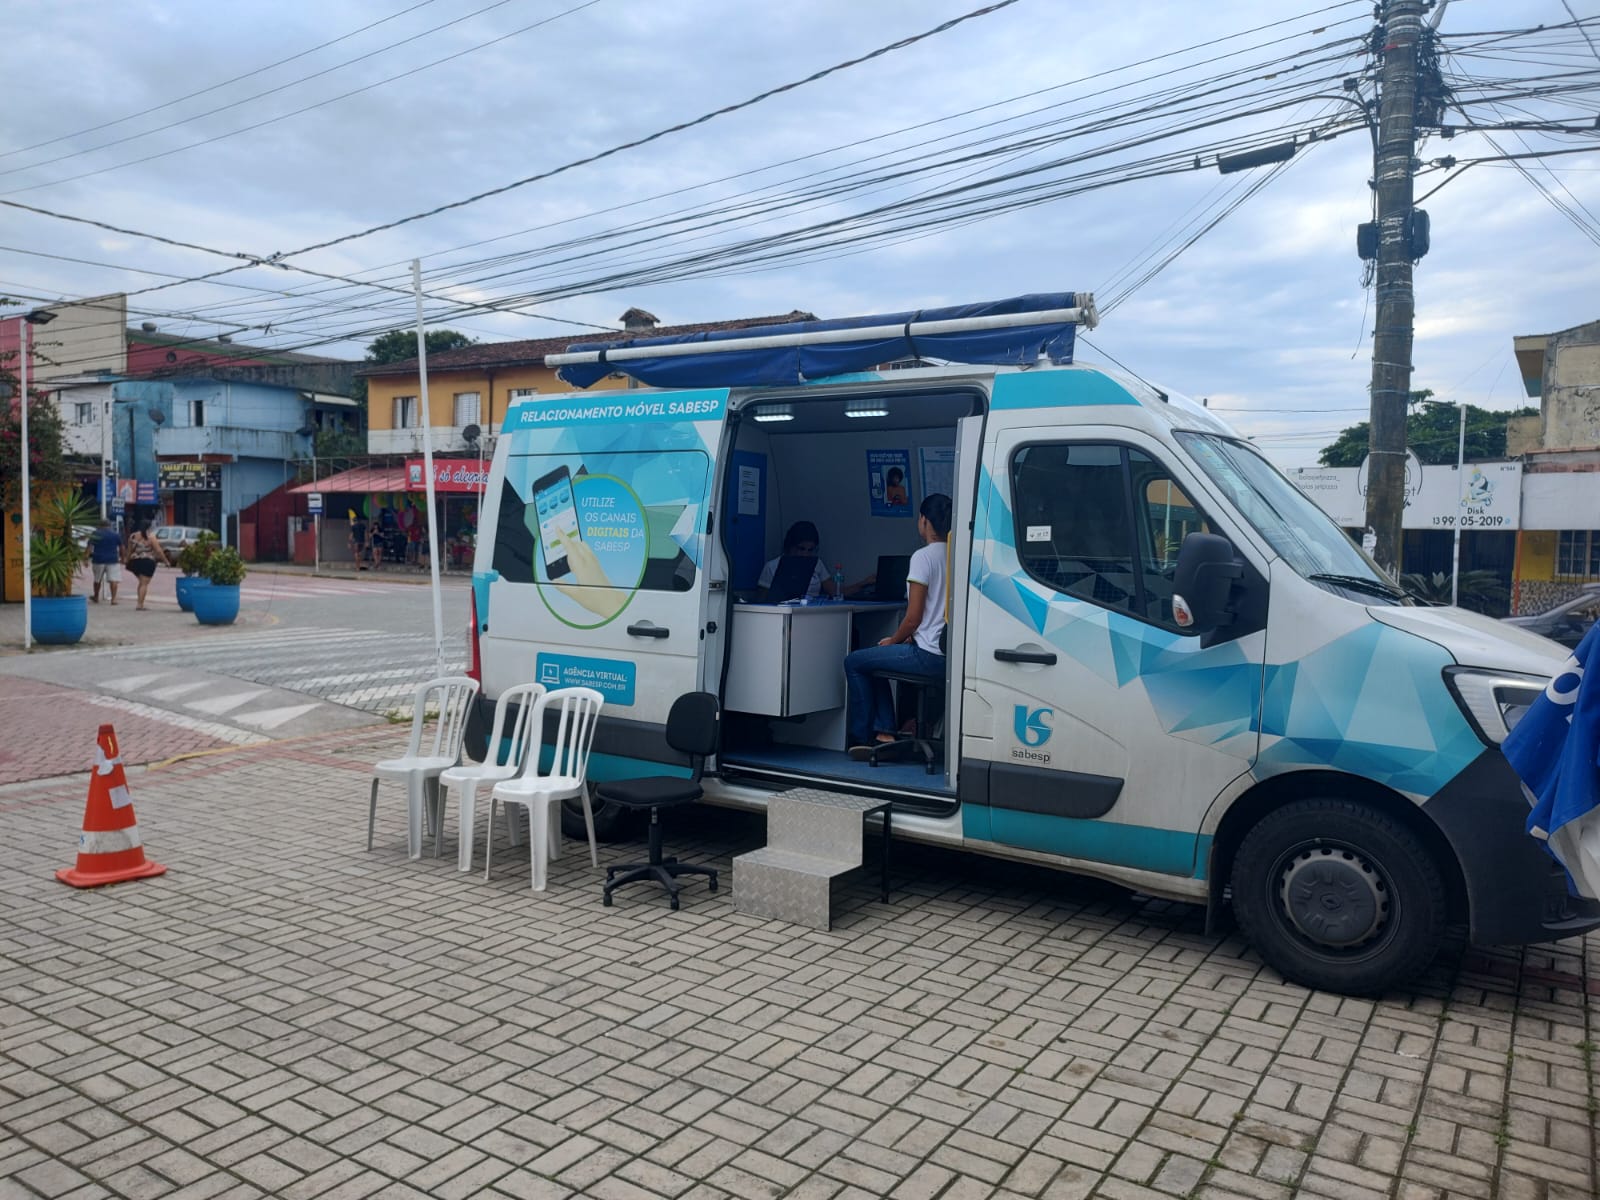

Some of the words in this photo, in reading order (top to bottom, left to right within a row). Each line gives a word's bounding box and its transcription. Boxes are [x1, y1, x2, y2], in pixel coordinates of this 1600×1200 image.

[521, 406, 623, 422] RELACIONAMENTO
[625, 401, 665, 416] MÓVEL
[668, 400, 719, 414] SABESP
[581, 497, 616, 508] UTILIZE
[1467, 507, 1485, 515] Disk
[585, 512, 599, 522] OS
[600, 512, 637, 523] CANAIS
[1432, 517, 1440, 525] 13
[1441, 516, 1504, 526] 9905-2019
[587, 527, 629, 538] DIGITAIS
[631, 528, 644, 538] DA
[593, 541, 631, 552] SABESP
[563, 666, 595, 678] AGÊNCIA
[1012, 748, 1050, 764] sabesp
